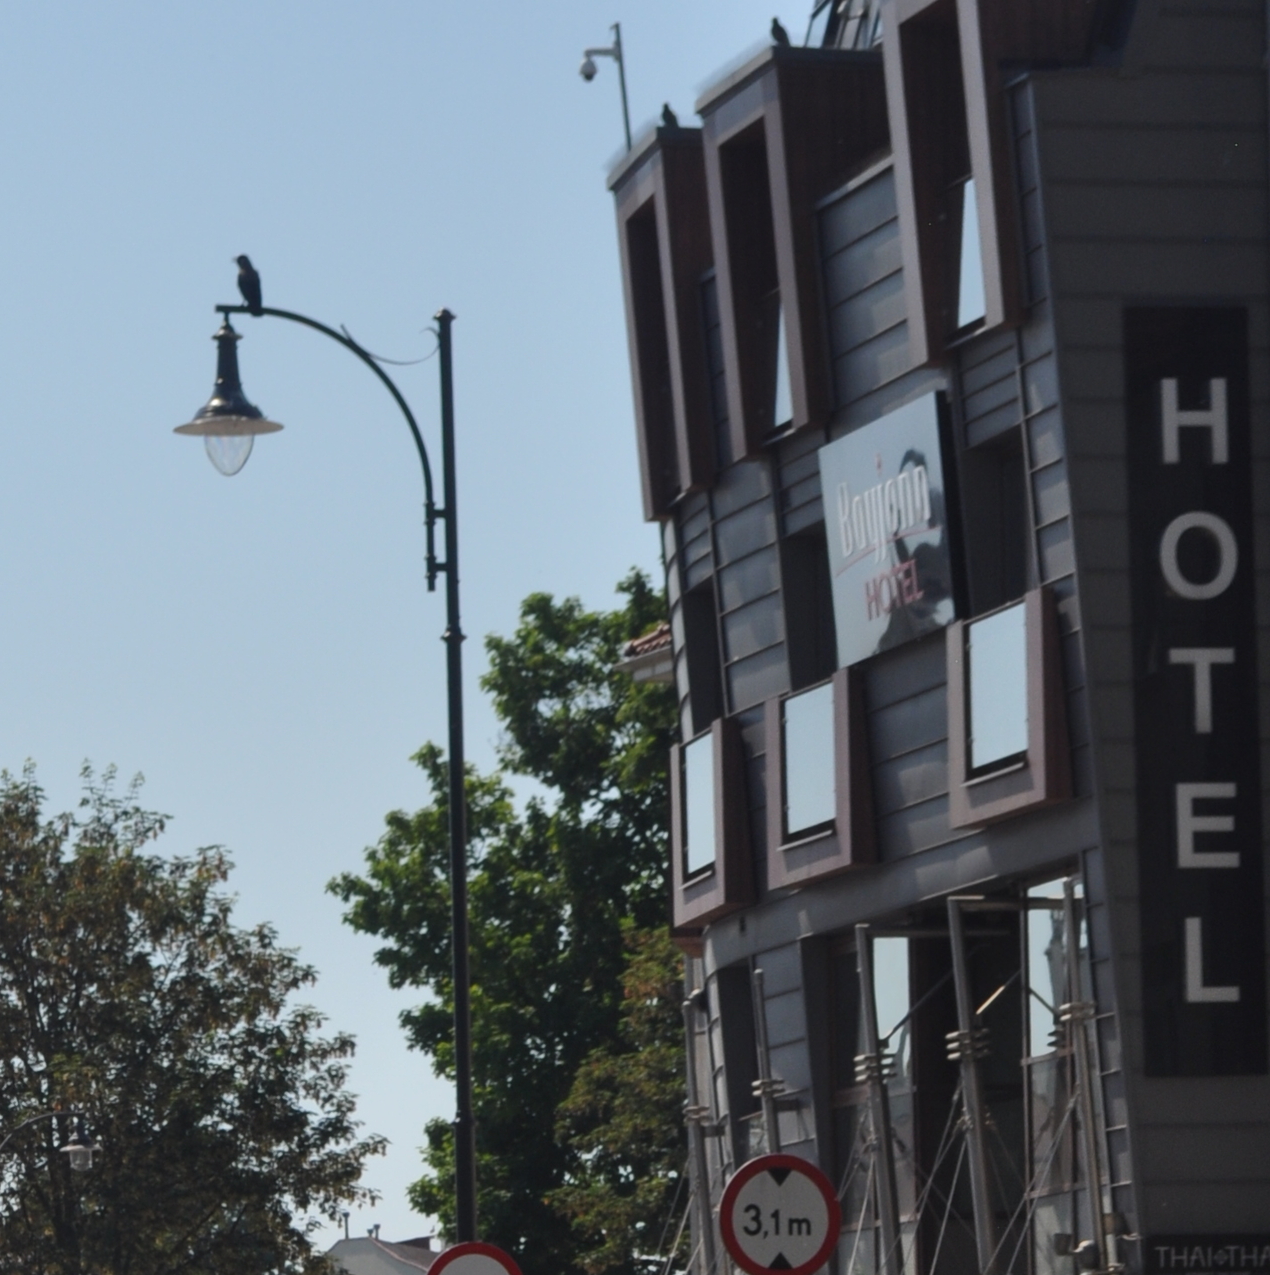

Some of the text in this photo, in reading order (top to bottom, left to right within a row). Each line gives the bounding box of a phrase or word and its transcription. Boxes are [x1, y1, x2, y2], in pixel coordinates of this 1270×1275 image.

[865, 558, 925, 622] HOTEL
[1160, 376, 1240, 1003] HOTEL
[1154, 1245, 1212, 1269] THAI
